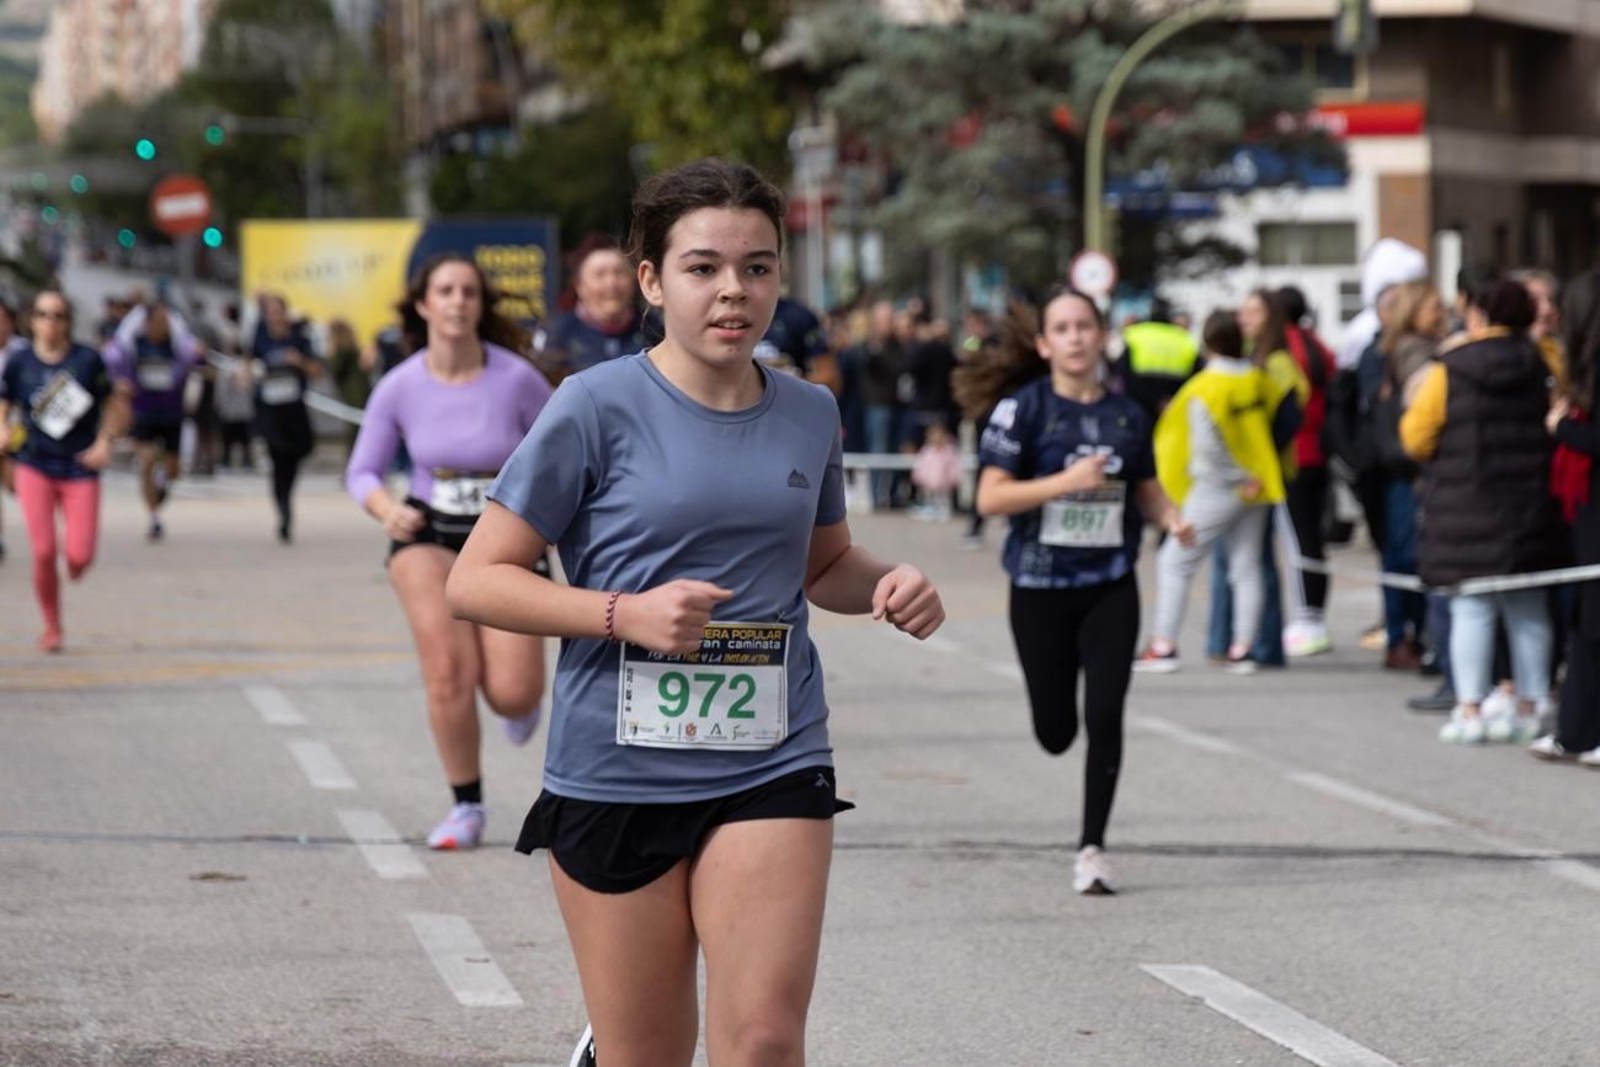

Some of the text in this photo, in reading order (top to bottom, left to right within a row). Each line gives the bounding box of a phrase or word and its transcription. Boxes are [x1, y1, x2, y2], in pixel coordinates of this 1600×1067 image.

[704, 629, 782, 640] ERA POPULAR
[727, 640, 781, 649] caminata
[658, 671, 757, 719] 972
